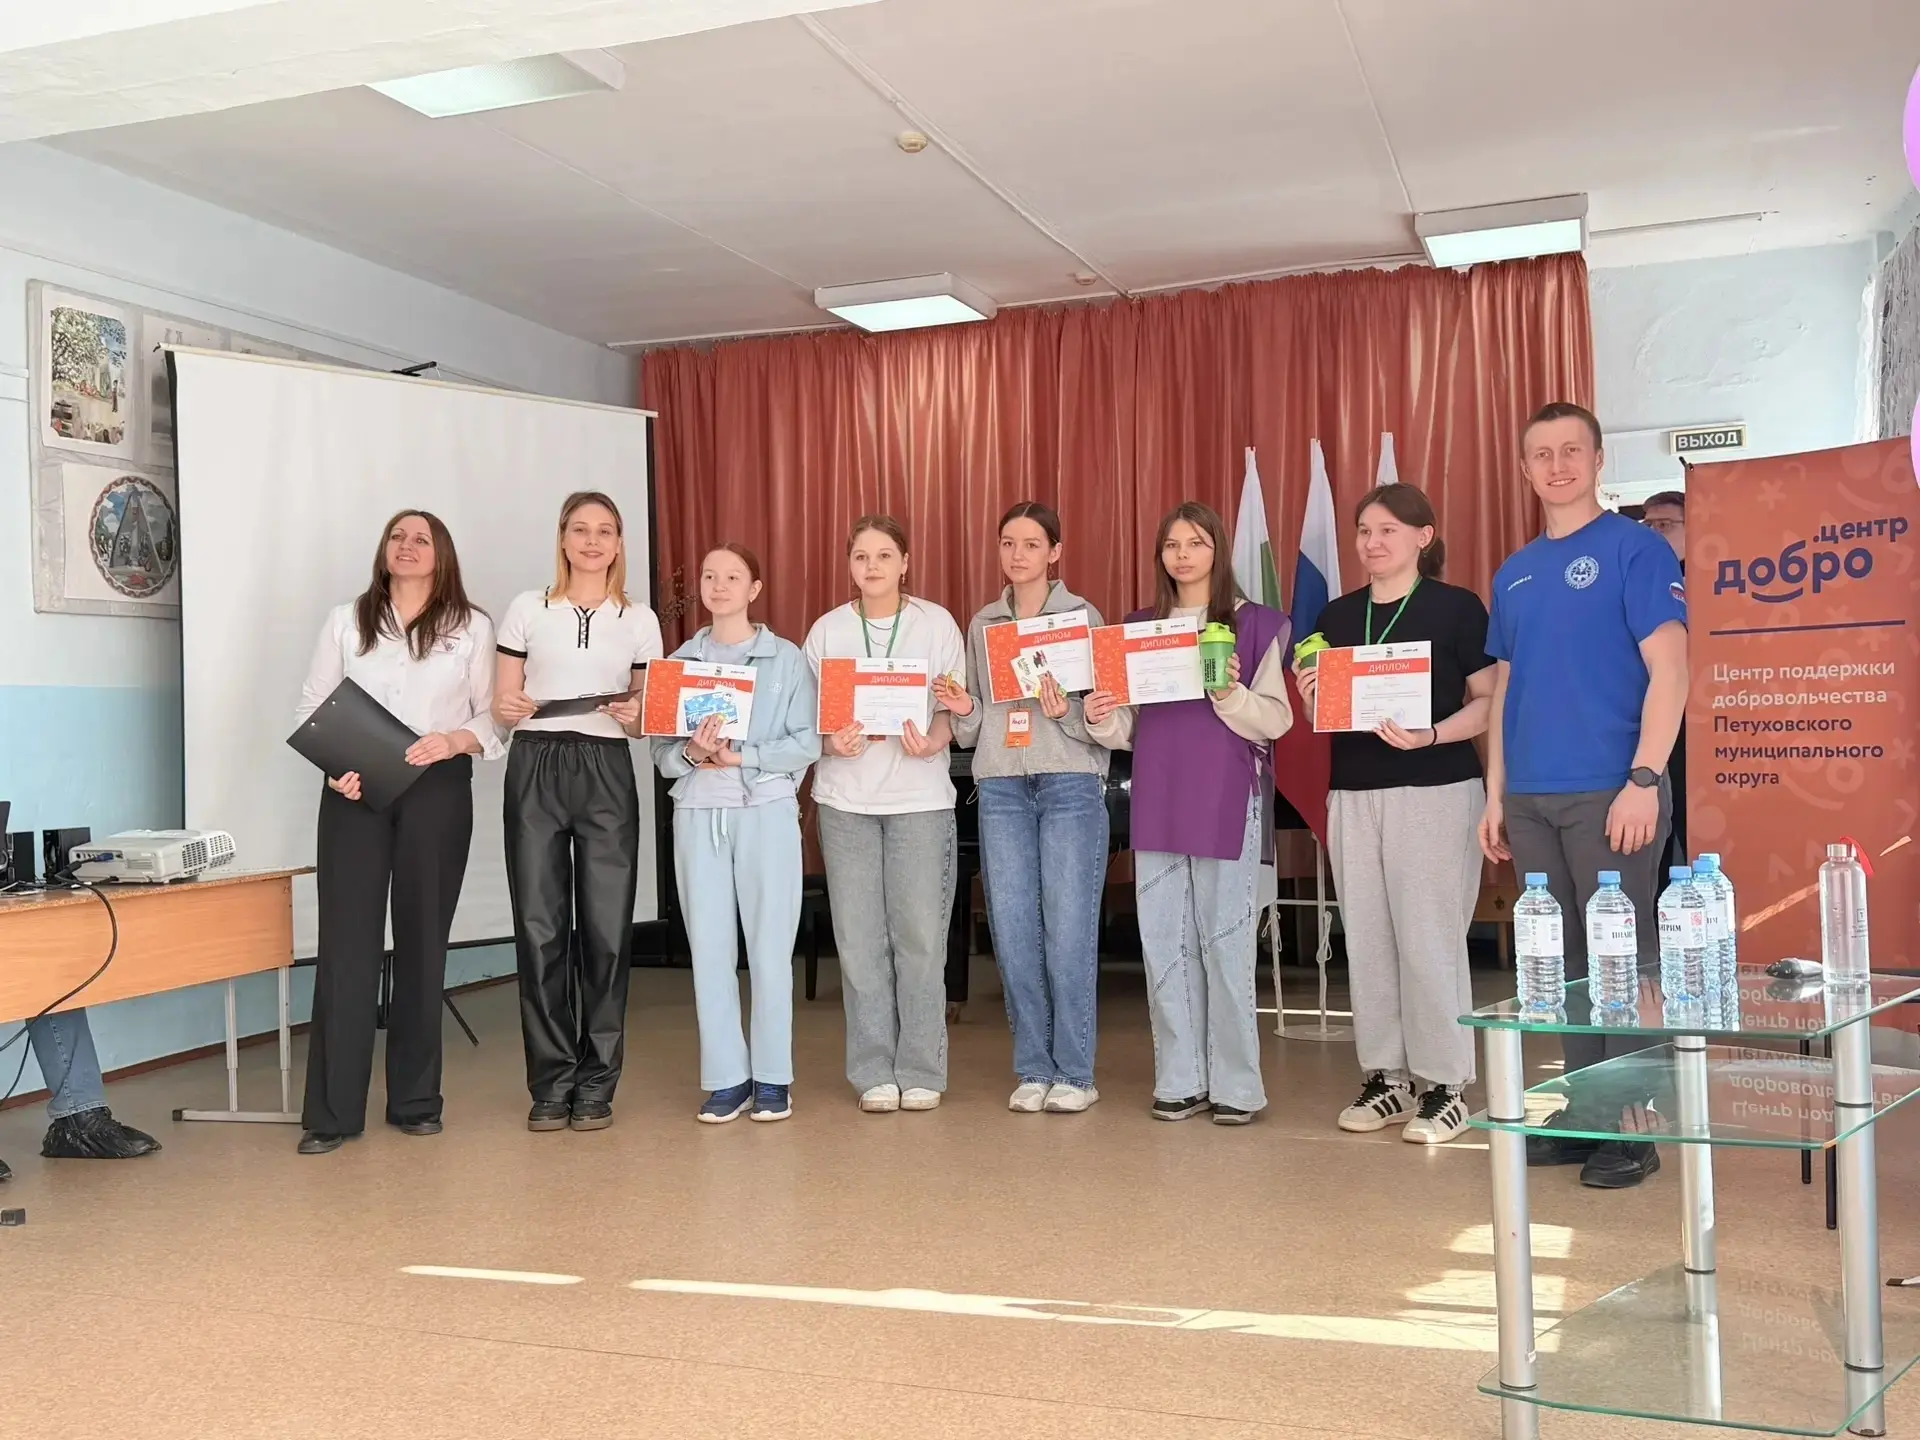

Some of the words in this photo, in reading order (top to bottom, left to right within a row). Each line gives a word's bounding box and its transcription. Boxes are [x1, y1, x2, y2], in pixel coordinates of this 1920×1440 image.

[1678, 431, 1739, 449] ВЫХОД
[1714, 539, 1873, 595] добро
[1033, 631, 1072, 644] ДИПЛОМ
[1140, 638, 1180, 650] ДИПЛОМ
[1368, 663, 1410, 673] ДИПЛОМ
[1713, 664, 1774, 683] Центр
[1779, 662, 1895, 681] поддержки
[870, 675, 910, 684] ДИПЛОМ
[1712, 690, 1888, 711] добровольчества
[1714, 716, 1852, 736] Петуховского
[1715, 745, 1884, 762] муниципального
[1715, 772, 1779, 788] округа
